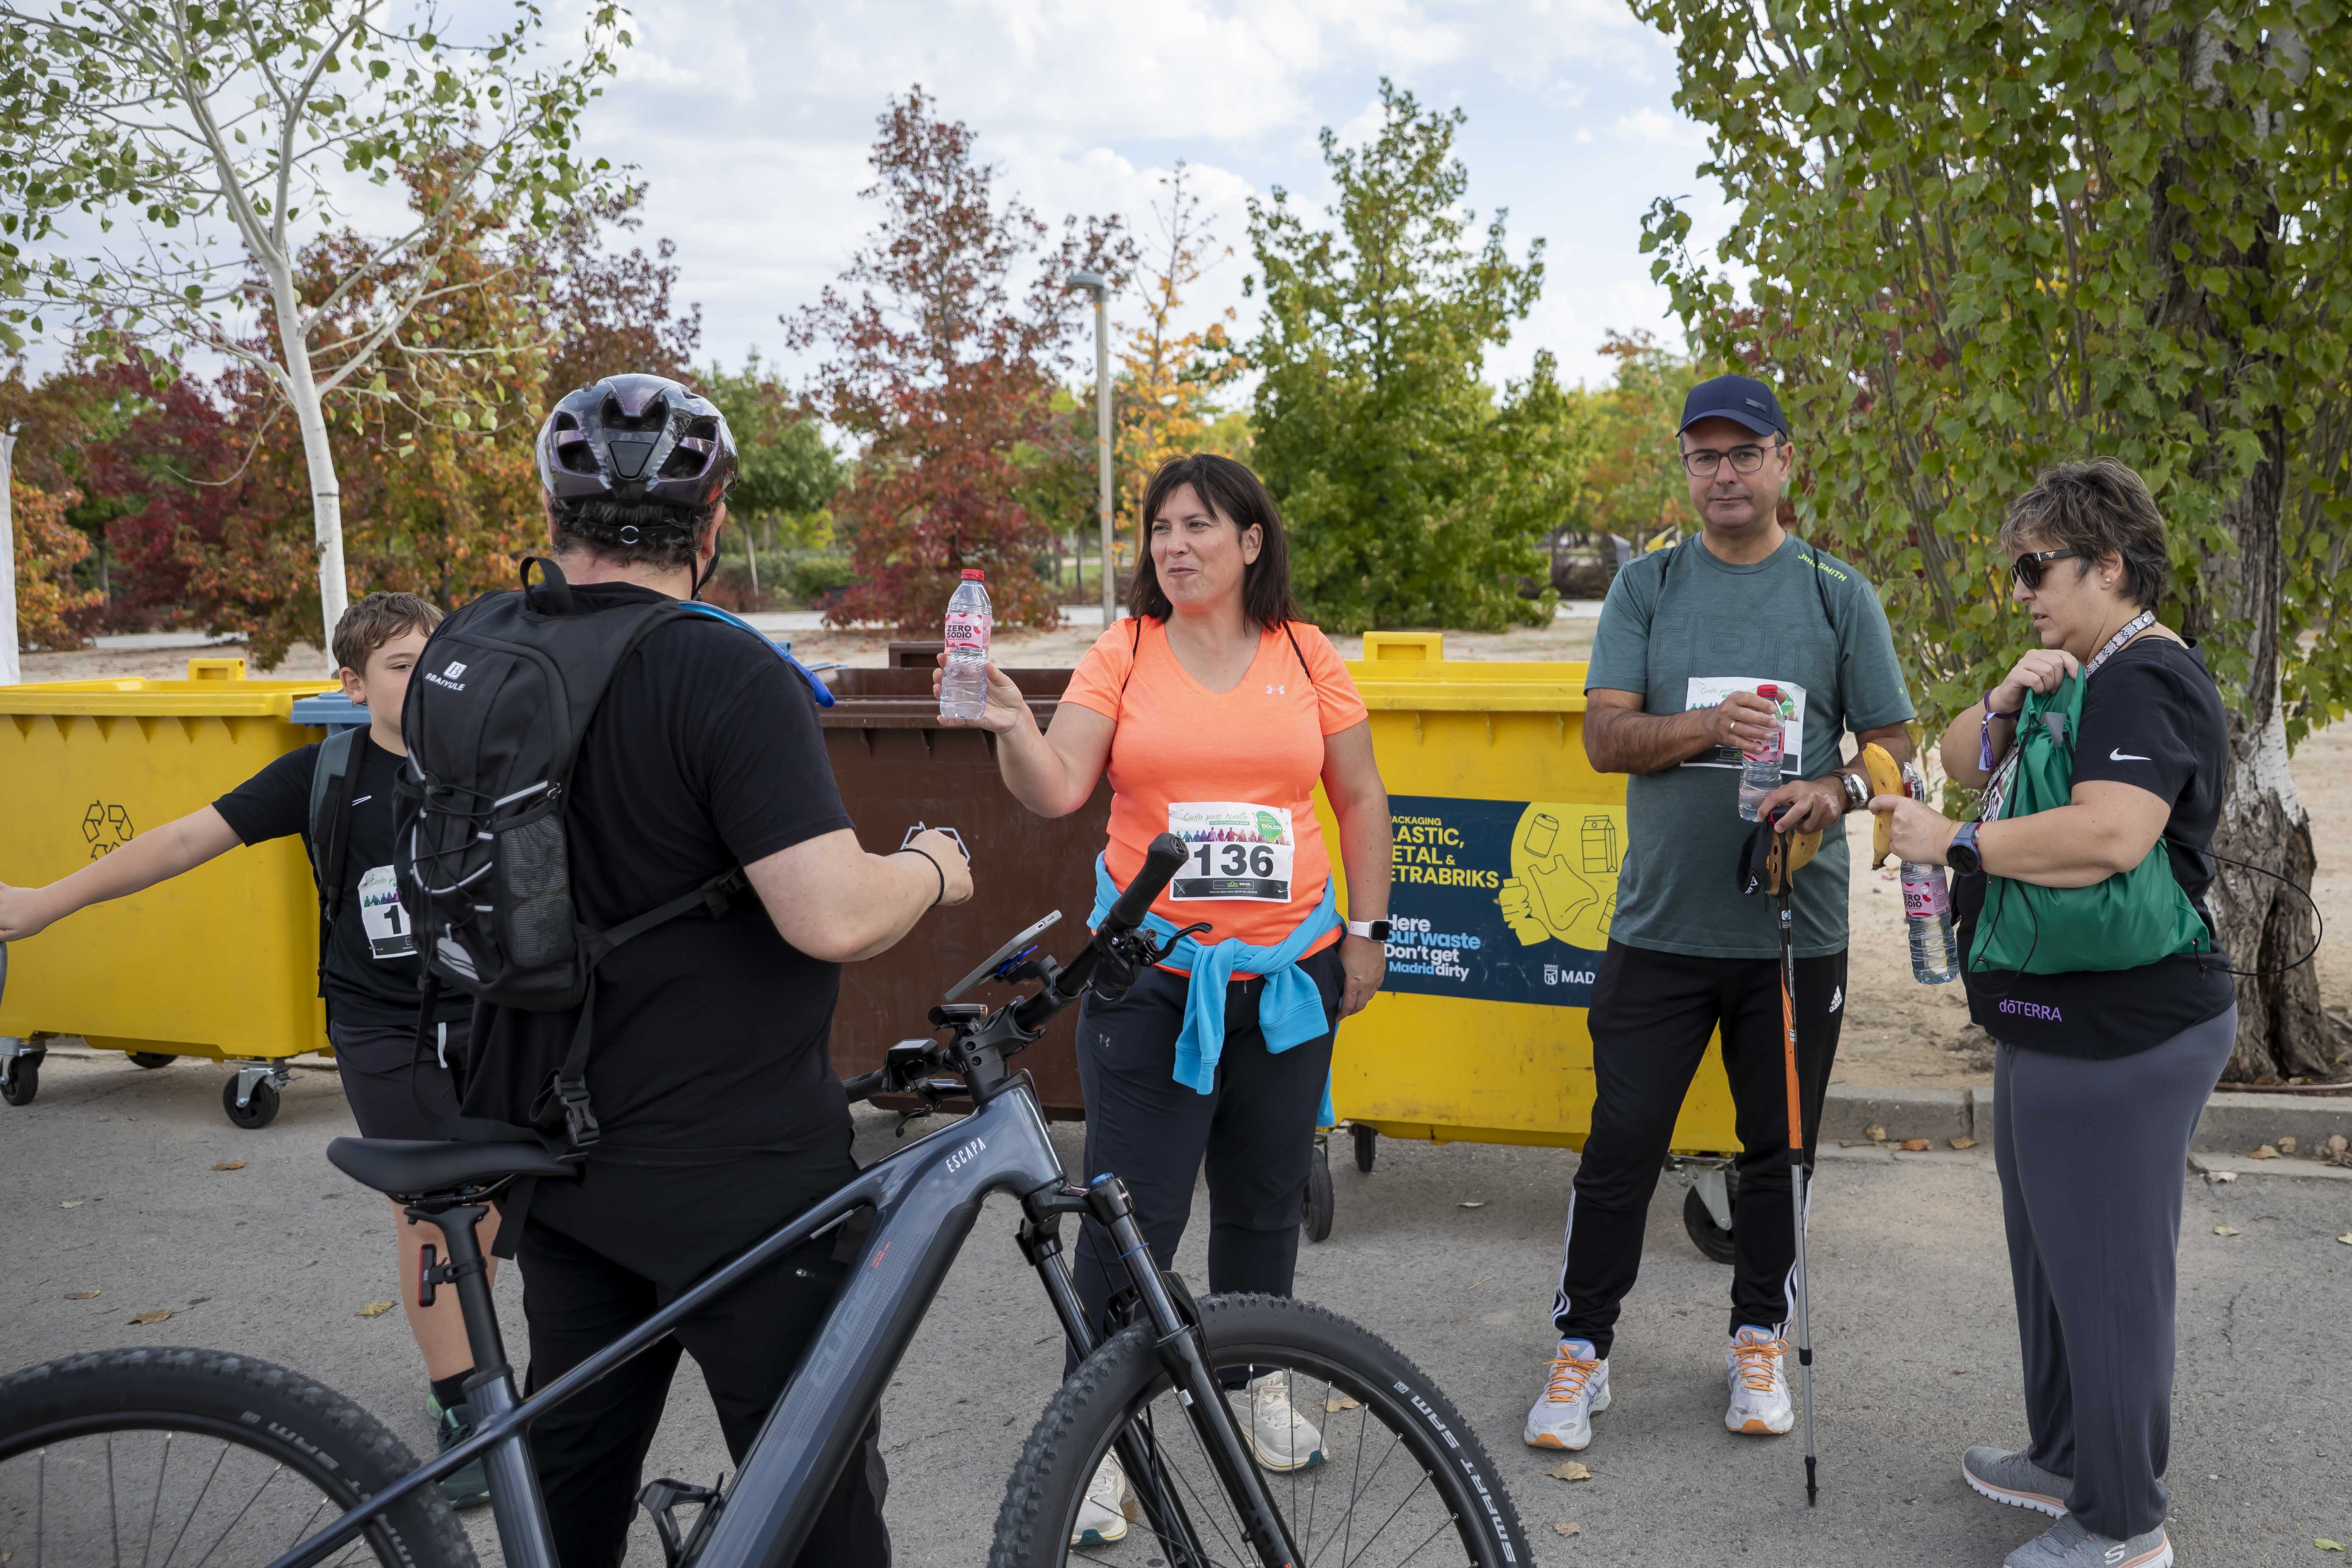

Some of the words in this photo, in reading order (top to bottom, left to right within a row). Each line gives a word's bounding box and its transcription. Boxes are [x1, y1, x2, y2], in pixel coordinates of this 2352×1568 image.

[425, 673, 465, 691] BBAIYULE
[1183, 813, 1203, 821] Cada
[1205, 814, 1222, 824] paso
[1225, 812, 1248, 821] cuenta
[1391, 815, 1441, 826] ACKAGING
[1392, 825, 1465, 848] ASTIC,
[1194, 844, 1275, 877] 136
[1392, 845, 1443, 864] ETAL
[1445, 854, 1455, 865] &
[1390, 865, 1499, 888] ETRABRIKS
[1387, 930, 1418, 944] our
[1420, 933, 1481, 949] waste
[1430, 949, 1459, 965] get
[1389, 961, 1435, 975] Madrid
[1435, 963, 1470, 982] dirty
[1561, 970, 1596, 984] MAD
[946, 1137, 986, 1173] ESCAPA
[810, 1270, 881, 1387] CUBE
[1411, 1395, 1460, 1448] SAM
[268, 1422, 339, 1470] SAM
[1460, 1459, 1516, 1562] SMART
